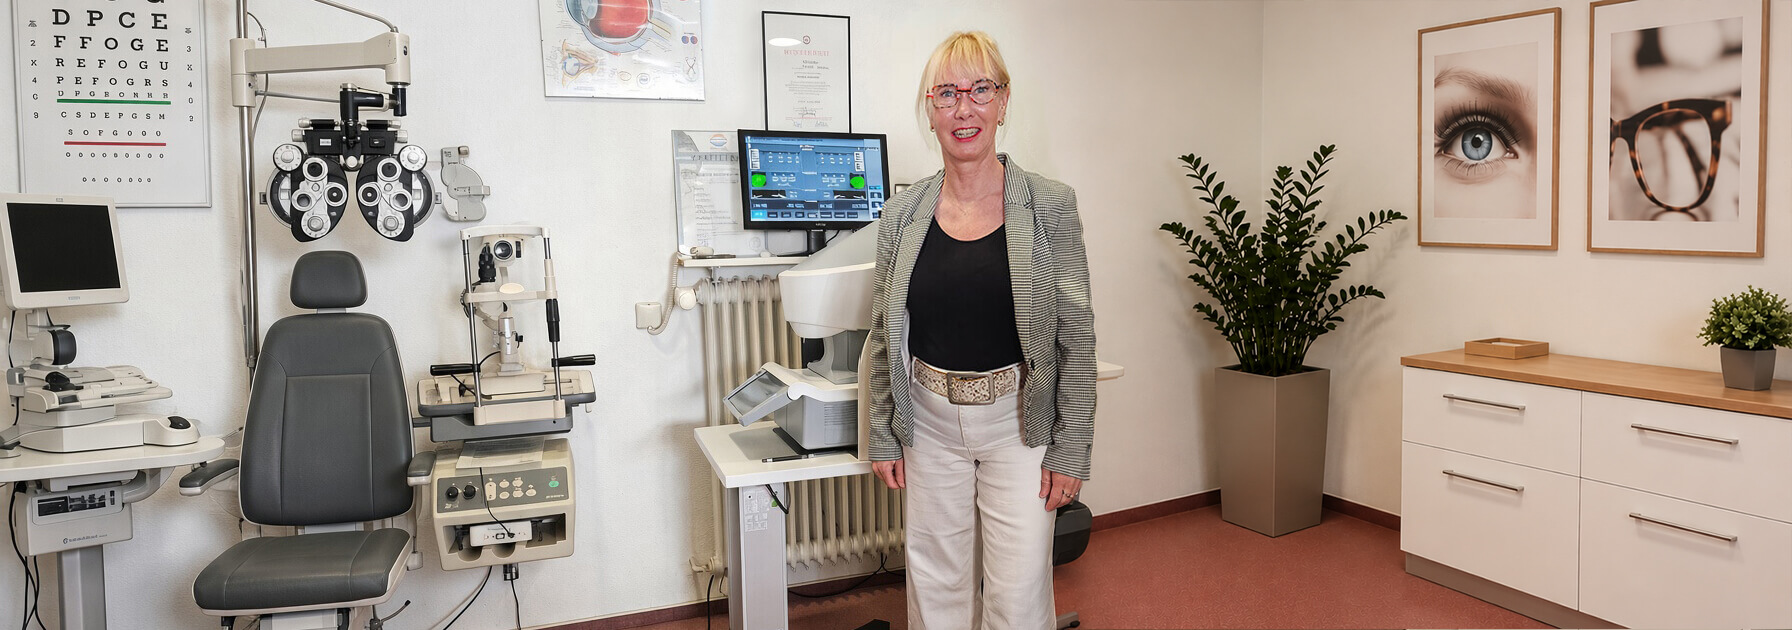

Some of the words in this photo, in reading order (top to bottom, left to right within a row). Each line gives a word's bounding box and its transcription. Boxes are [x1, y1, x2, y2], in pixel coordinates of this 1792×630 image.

[52, 8, 70, 25] D
[86, 10, 103, 27] P
[118, 11, 136, 29] C
[151, 13, 168, 30] E
[53, 35, 66, 48] F
[79, 36, 92, 49] F
[104, 37, 119, 50] O
[130, 38, 144, 51] G
[156, 39, 169, 52] E
